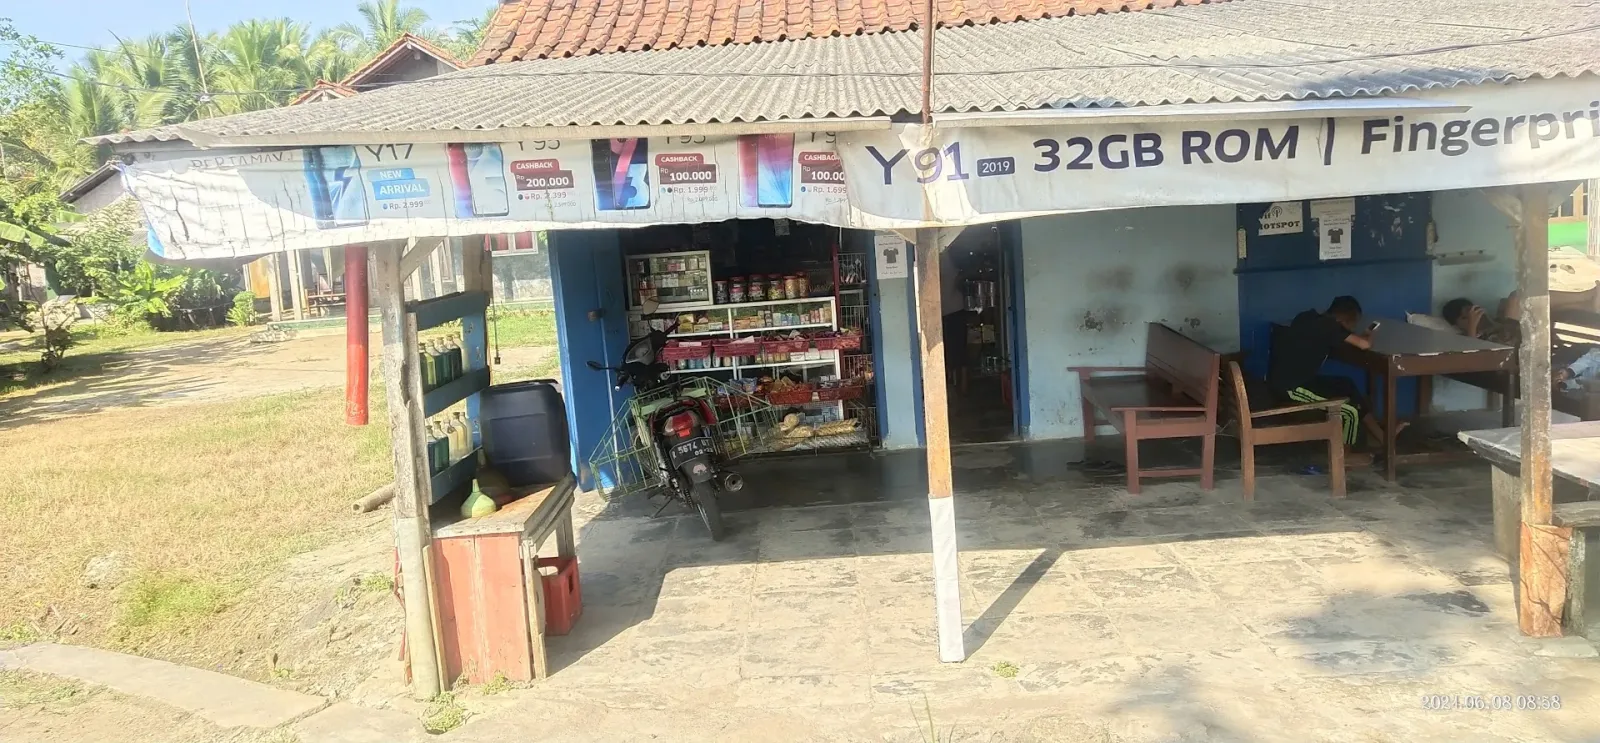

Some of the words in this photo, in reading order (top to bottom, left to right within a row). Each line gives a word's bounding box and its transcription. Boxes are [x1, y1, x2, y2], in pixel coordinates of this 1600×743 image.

[865, 142, 969, 186] Y91
[982, 160, 1011, 174] 2019
[1032, 132, 1164, 173] 32GB
[1181, 125, 1299, 165] ROM
[1361, 101, 1600, 157] Fingerpri
[365, 143, 413, 162] Y17
[660, 155, 698, 163] CASHBACK
[516, 161, 553, 170] CASHBACK
[380, 170, 402, 180] NEW
[669, 171, 712, 182] 100.000
[526, 176, 569, 188] 200.000
[380, 184, 425, 195] ARRIVAL
